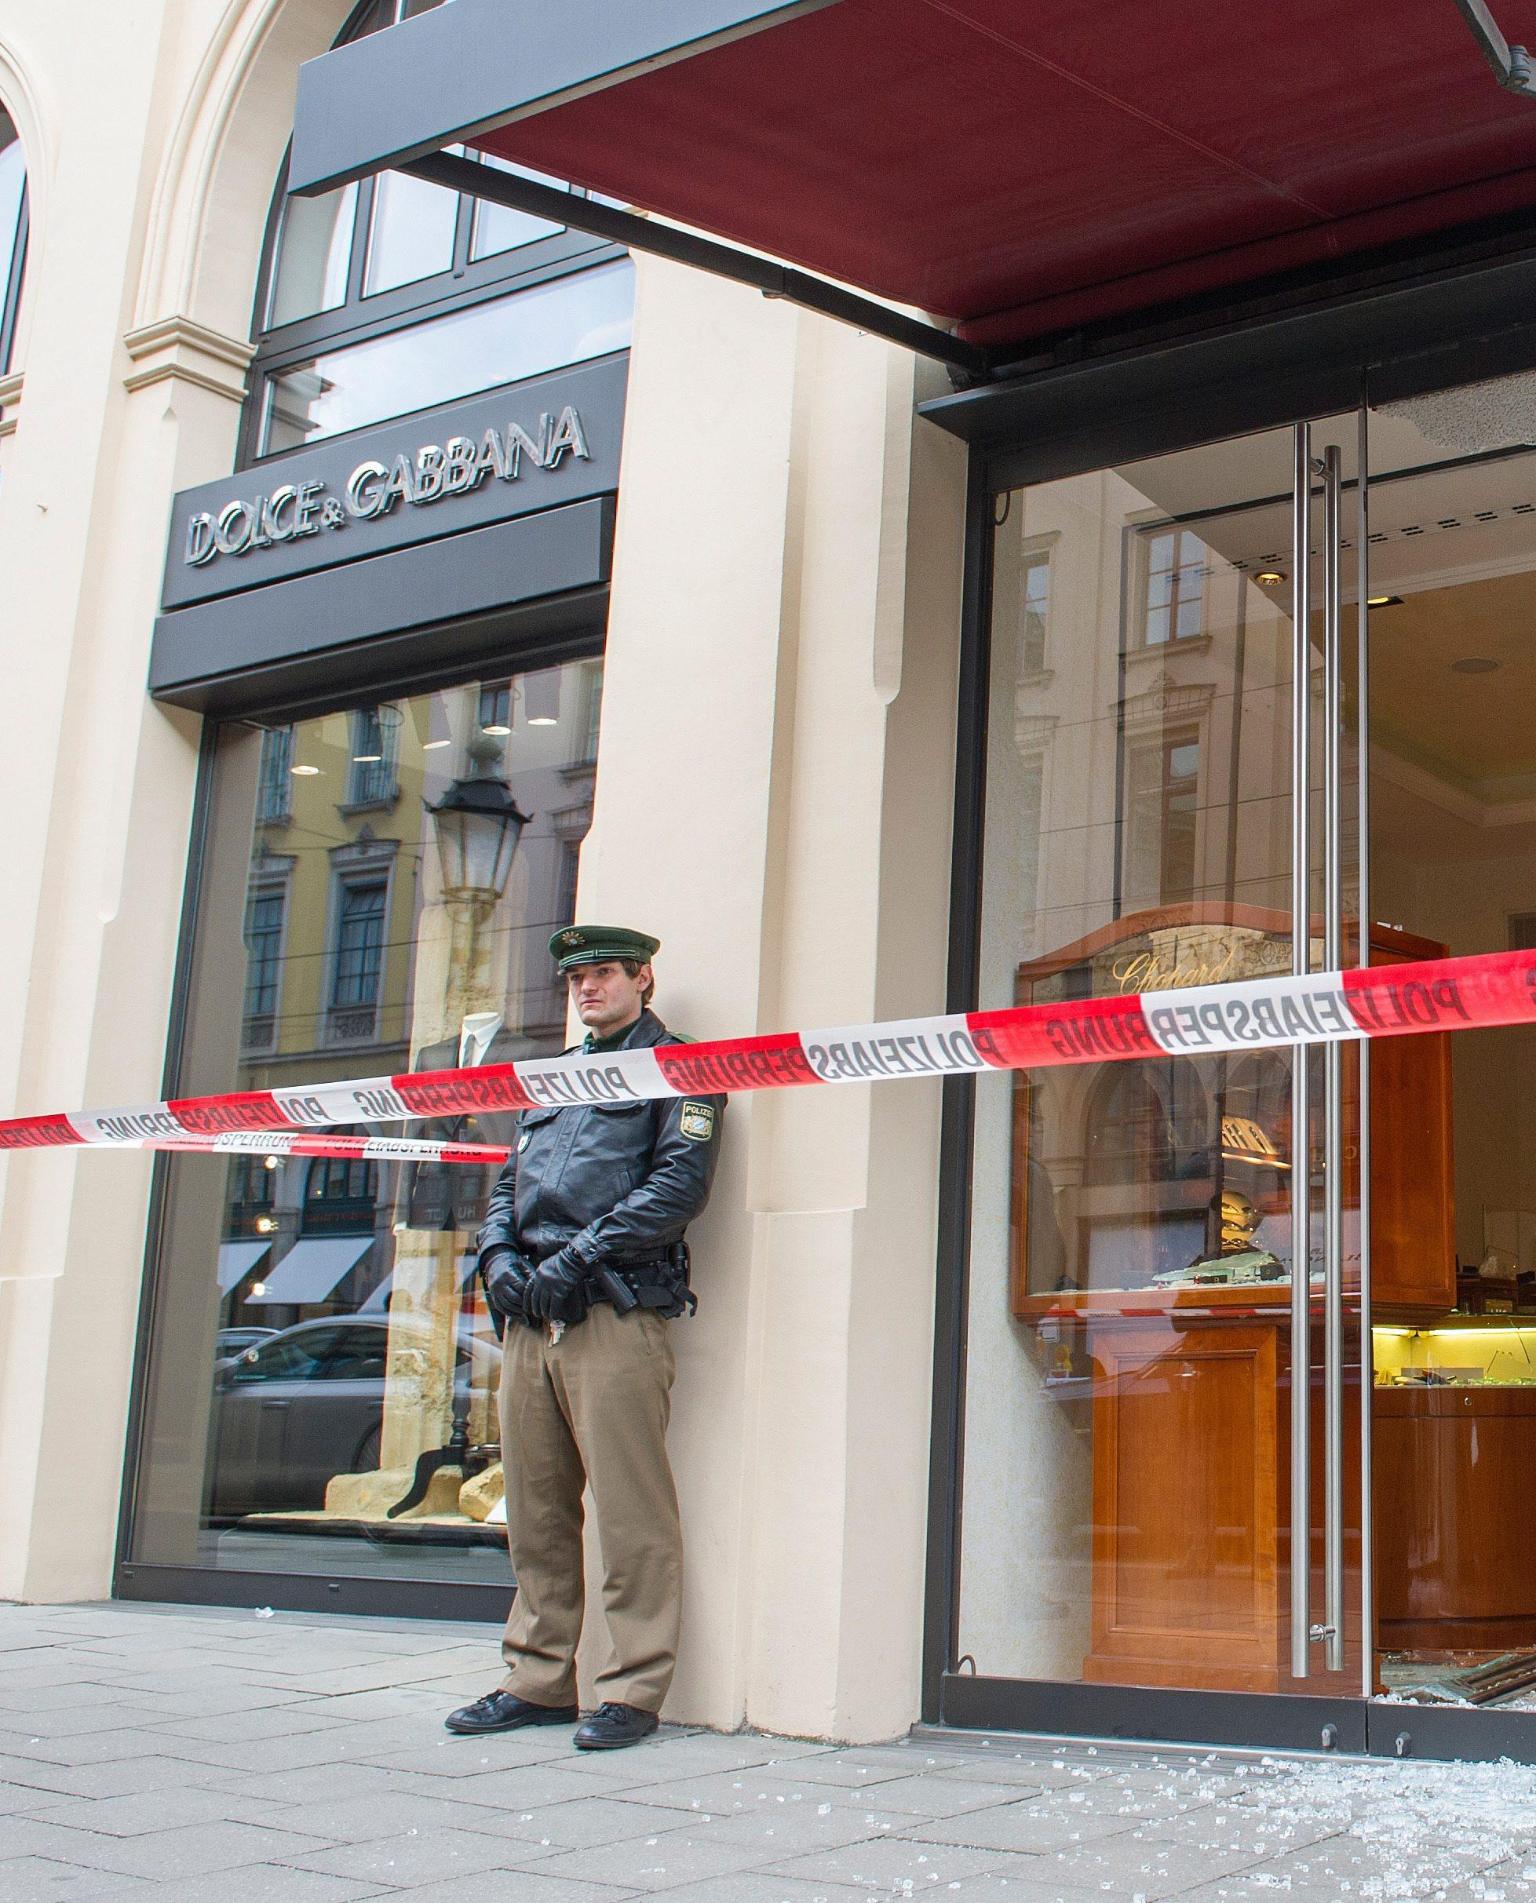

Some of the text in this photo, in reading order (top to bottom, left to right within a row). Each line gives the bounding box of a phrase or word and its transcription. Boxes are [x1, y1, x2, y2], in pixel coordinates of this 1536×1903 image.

[184, 405, 592, 566] DOLCE & GABBANA
